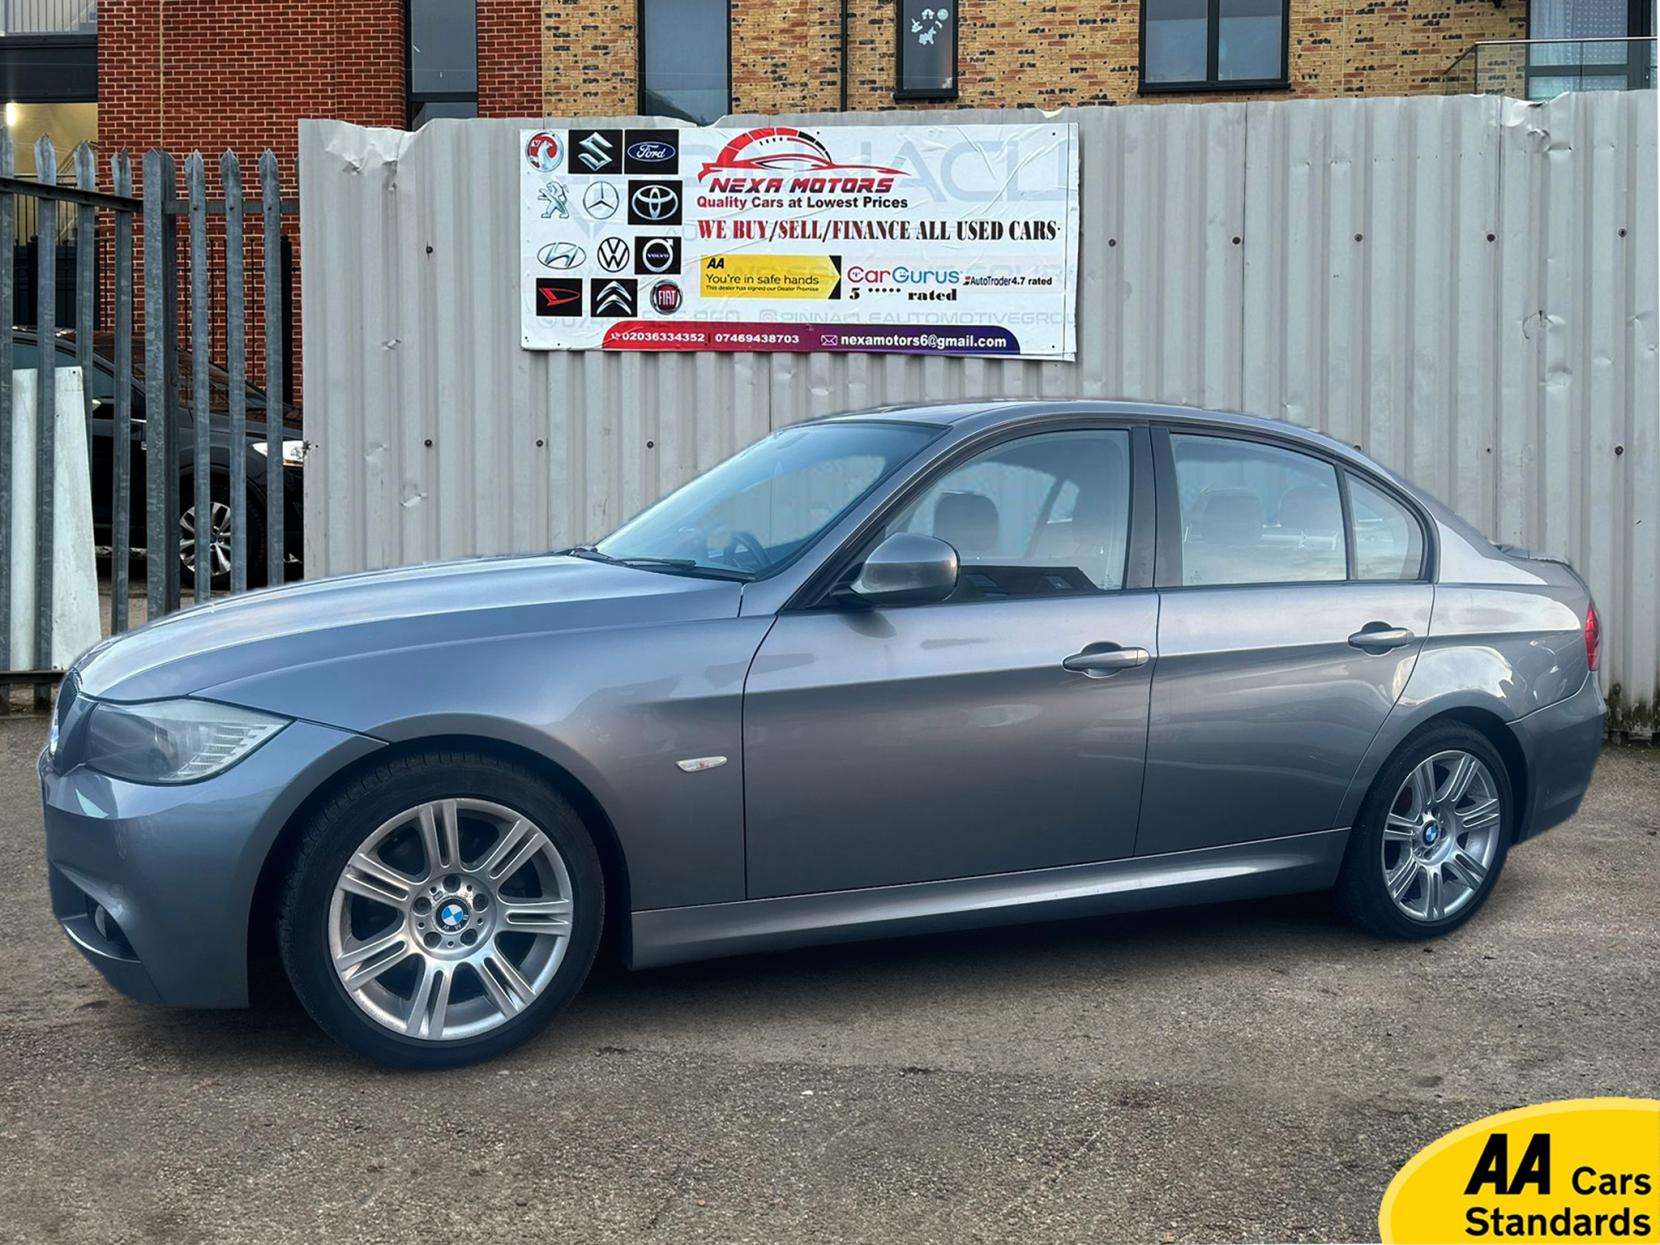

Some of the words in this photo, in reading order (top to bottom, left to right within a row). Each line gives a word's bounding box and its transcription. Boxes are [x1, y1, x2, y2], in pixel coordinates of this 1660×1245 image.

[636, 144, 665, 158] Ford
[709, 178, 783, 193] NEXA
[789, 178, 894, 193] MOTORS
[697, 196, 747, 209] Quality
[752, 197, 783, 208] Cars
[788, 197, 802, 208] at
[807, 197, 858, 208] Lowest
[863, 196, 908, 208] Prices
[698, 220, 727, 240] WE
[733, 220, 910, 243] BUY/SELL/FINANCE
[916, 221, 950, 240] ALL
[957, 221, 1003, 240] USED
[1009, 221, 1058, 240] CARS
[707, 257, 724, 269] AA
[706, 274, 741, 284] You're
[744, 274, 754, 284] in
[757, 274, 781, 285] safe
[784, 275, 819, 285] hands
[847, 266, 960, 284] CarGurus
[1028, 276, 1052, 286] rated
[658, 290, 676, 305] FIAT
[849, 288, 861, 300] 5
[908, 288, 957, 301] rated
[622, 332, 705, 342] 02036334352
[715, 333, 800, 344] 07469438703
[841, 334, 1007, 350] nexamotors6@gmail.com
